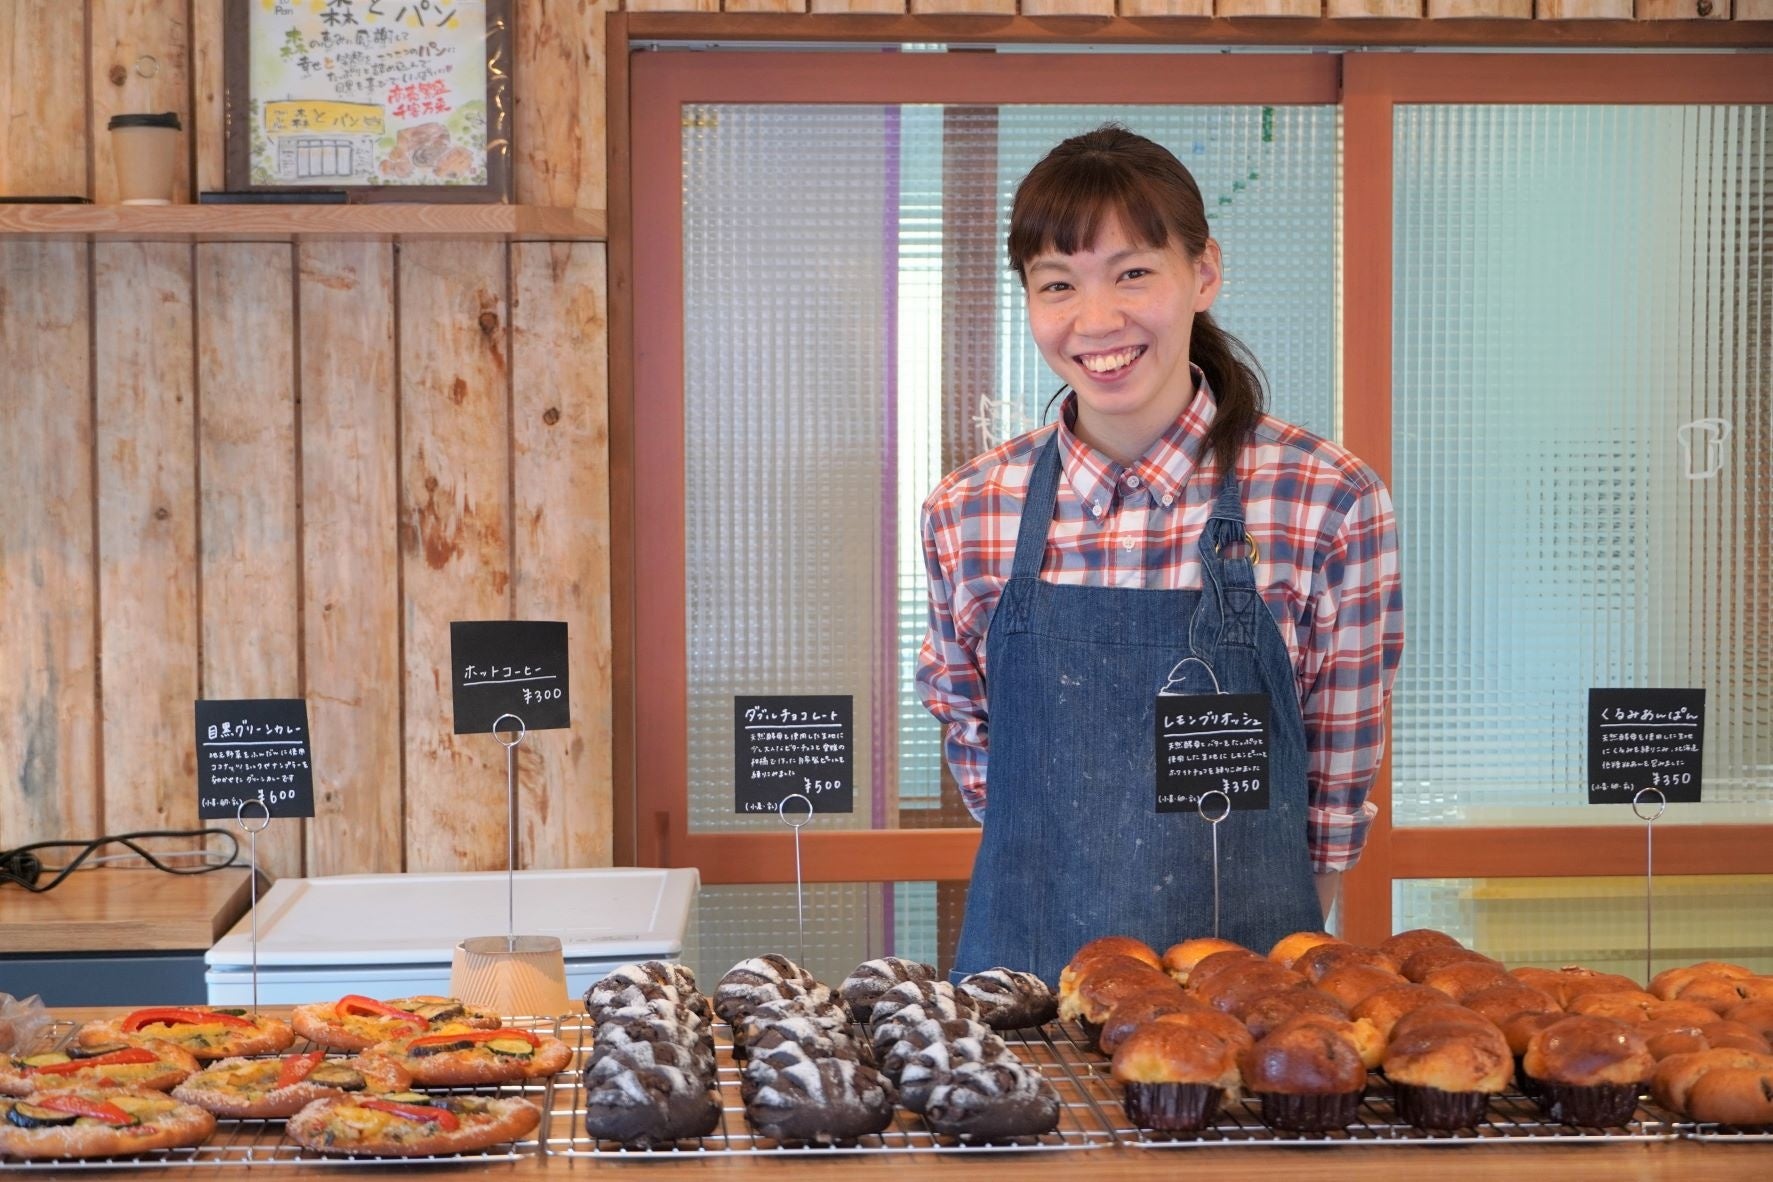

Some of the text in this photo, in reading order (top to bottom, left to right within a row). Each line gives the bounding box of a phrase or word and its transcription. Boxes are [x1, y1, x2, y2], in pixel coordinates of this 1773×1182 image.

[275, 5, 294, 16] Pan
[464, 665, 542, 679] ホットコーヒー
[522, 688, 562, 705] ¥300
[745, 705, 838, 723] ダブルチョコレート
[1164, 711, 1262, 728] レモンブリオッシュ
[1601, 706, 1698, 721] くるみあんぱん
[208, 719, 301, 740] 目黒グリーンカレー
[803, 777, 841, 794] ¥500
[1222, 778, 1260, 793] ¥350
[1652, 772, 1692, 787] ¥350
[257, 789, 296, 804] ¥600
